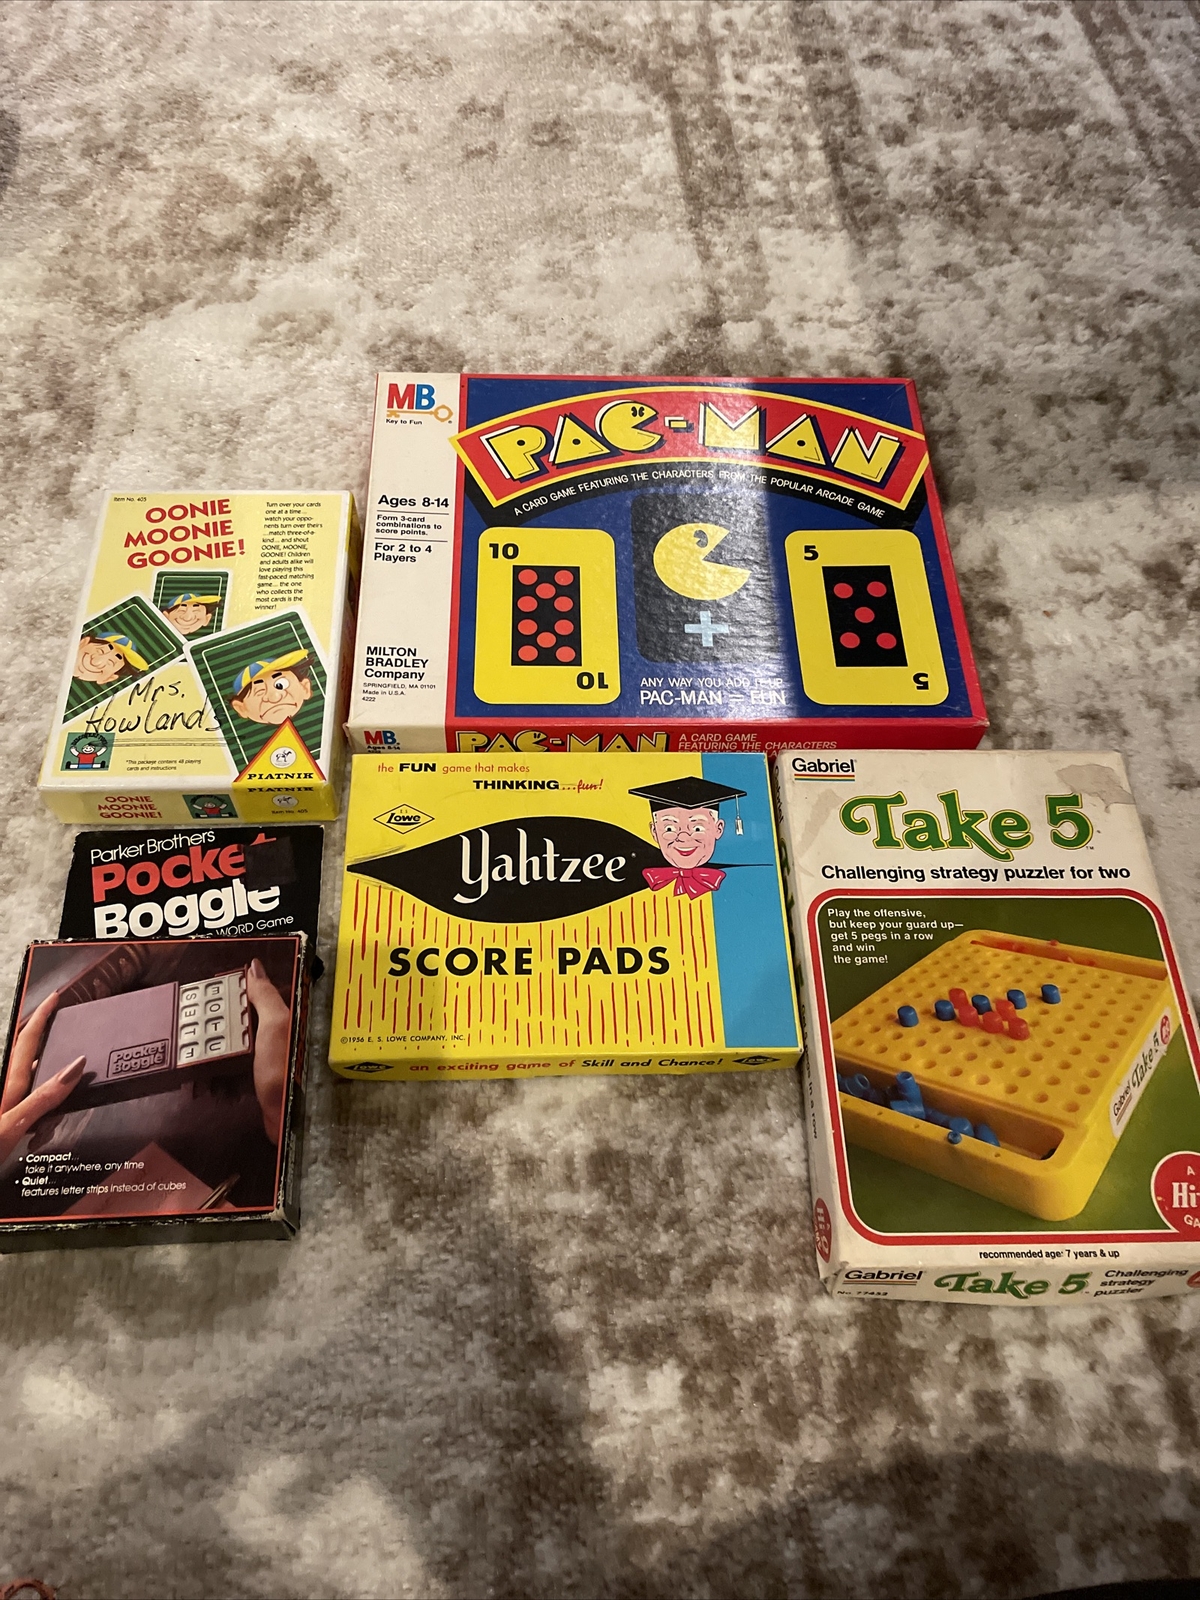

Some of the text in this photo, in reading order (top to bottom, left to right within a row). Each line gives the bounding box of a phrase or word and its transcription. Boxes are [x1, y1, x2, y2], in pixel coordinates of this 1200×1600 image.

[387, 383, 435, 409] MB
[479, 400, 904, 484] PAC-MAN
[514, 470, 886, 519] A CARD GAME FEATURING THE CHARACTERS FROM THE POPULAR ARCADE GAME
[378, 495, 449, 508] Ages 8-14
[146, 499, 231, 523] OONIE
[376, 521, 431, 529] combinations
[124, 520, 234, 548] MOONIE
[127, 539, 245, 569] GOONIE!
[375, 542, 432, 553] For 2 to 4
[489, 543, 519, 559] 10
[804, 545, 819, 560] 5
[374, 552, 416, 563] Players
[367, 646, 416, 657] MILTON
[366, 657, 428, 668] BRADLEY
[364, 668, 425, 681] Company
[576, 672, 608, 689] 10
[640, 677, 662, 687] ANY
[668, 677, 692, 687] WAY
[698, 677, 723, 687] YOU
[726, 678, 752, 688] ADD
[913, 673, 929, 690] 5
[129, 677, 184, 705] Mrs.
[640, 690, 787, 705] PAC-MAN FUN
[364, 731, 396, 744] MB
[455, 729, 669, 752] PAC-MAN
[691, 734, 722, 742] CARD
[725, 734, 757, 742] GAME
[678, 741, 837, 750] FEATURING THE CHARACTERS
[378, 763, 530, 774] the FUN game that makes
[792, 757, 855, 774] Gabriel
[100, 811, 163, 819] GOONIE!
[386, 813, 421, 823] Lowe
[839, 789, 1034, 862] Take
[1045, 793, 1093, 850] 5
[91, 831, 216, 865] Parker Brothers
[822, 865, 1130, 882] Challenging strategy puzzler for two
[94, 878, 280, 938] Boggle
[827, 909, 926, 919] Play the offensive,
[216, 923, 254, 936] WORD
[256, 916, 294, 929] Game
[829, 920, 846, 928] but
[850, 920, 876, 930] keep
[879, 921, 902, 930] your
[906, 920, 937, 930] guard
[831, 933, 848, 942] get
[851, 932, 858, 940] 5
[861, 933, 887, 942] pegs
[891, 932, 900, 940] in
[833, 943, 875, 951] and win
[388, 946, 671, 977] SCORE PADS
[834, 955, 888, 965] the game!
[437, 1062, 498, 1072] exciting
[506, 1062, 551, 1072] game
[559, 1060, 576, 1068] of
[582, 1059, 614, 1067] Skill
[620, 1059, 652, 1067] and
[658, 1058, 724, 1067] Chance!
[25, 1161, 144, 1174] take it anywhere, any time
[21, 1181, 186, 1197] features letter strips instead of cubes
[979, 1249, 1120, 1260] recommended age: 7 years & up
[845, 1270, 923, 1280] Gabriel
[1105, 1269, 1189, 1278] Challenging
[934, 1272, 1093, 1299] Take 5
[1100, 1279, 1155, 1287] strategy
[1094, 1287, 1144, 1297] puzzler
